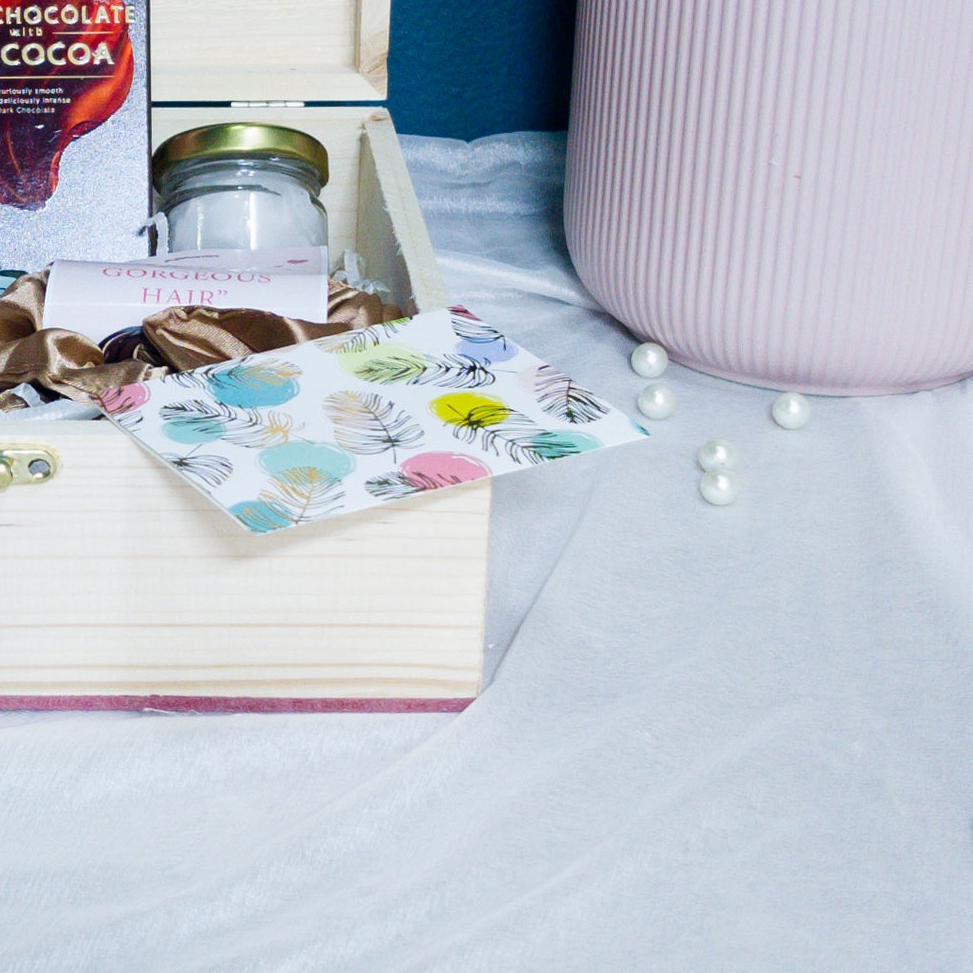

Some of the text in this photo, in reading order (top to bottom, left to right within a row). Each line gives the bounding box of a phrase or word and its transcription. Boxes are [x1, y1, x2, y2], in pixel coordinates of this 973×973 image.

[9, 27, 43, 37] with
[0, 42, 115, 67] COCOA
[34, 87, 64, 95] smooth
[42, 96, 72, 104] intense
[16, 106, 56, 114] Chocolate
[102, 266, 272, 283] GORGEOUS
